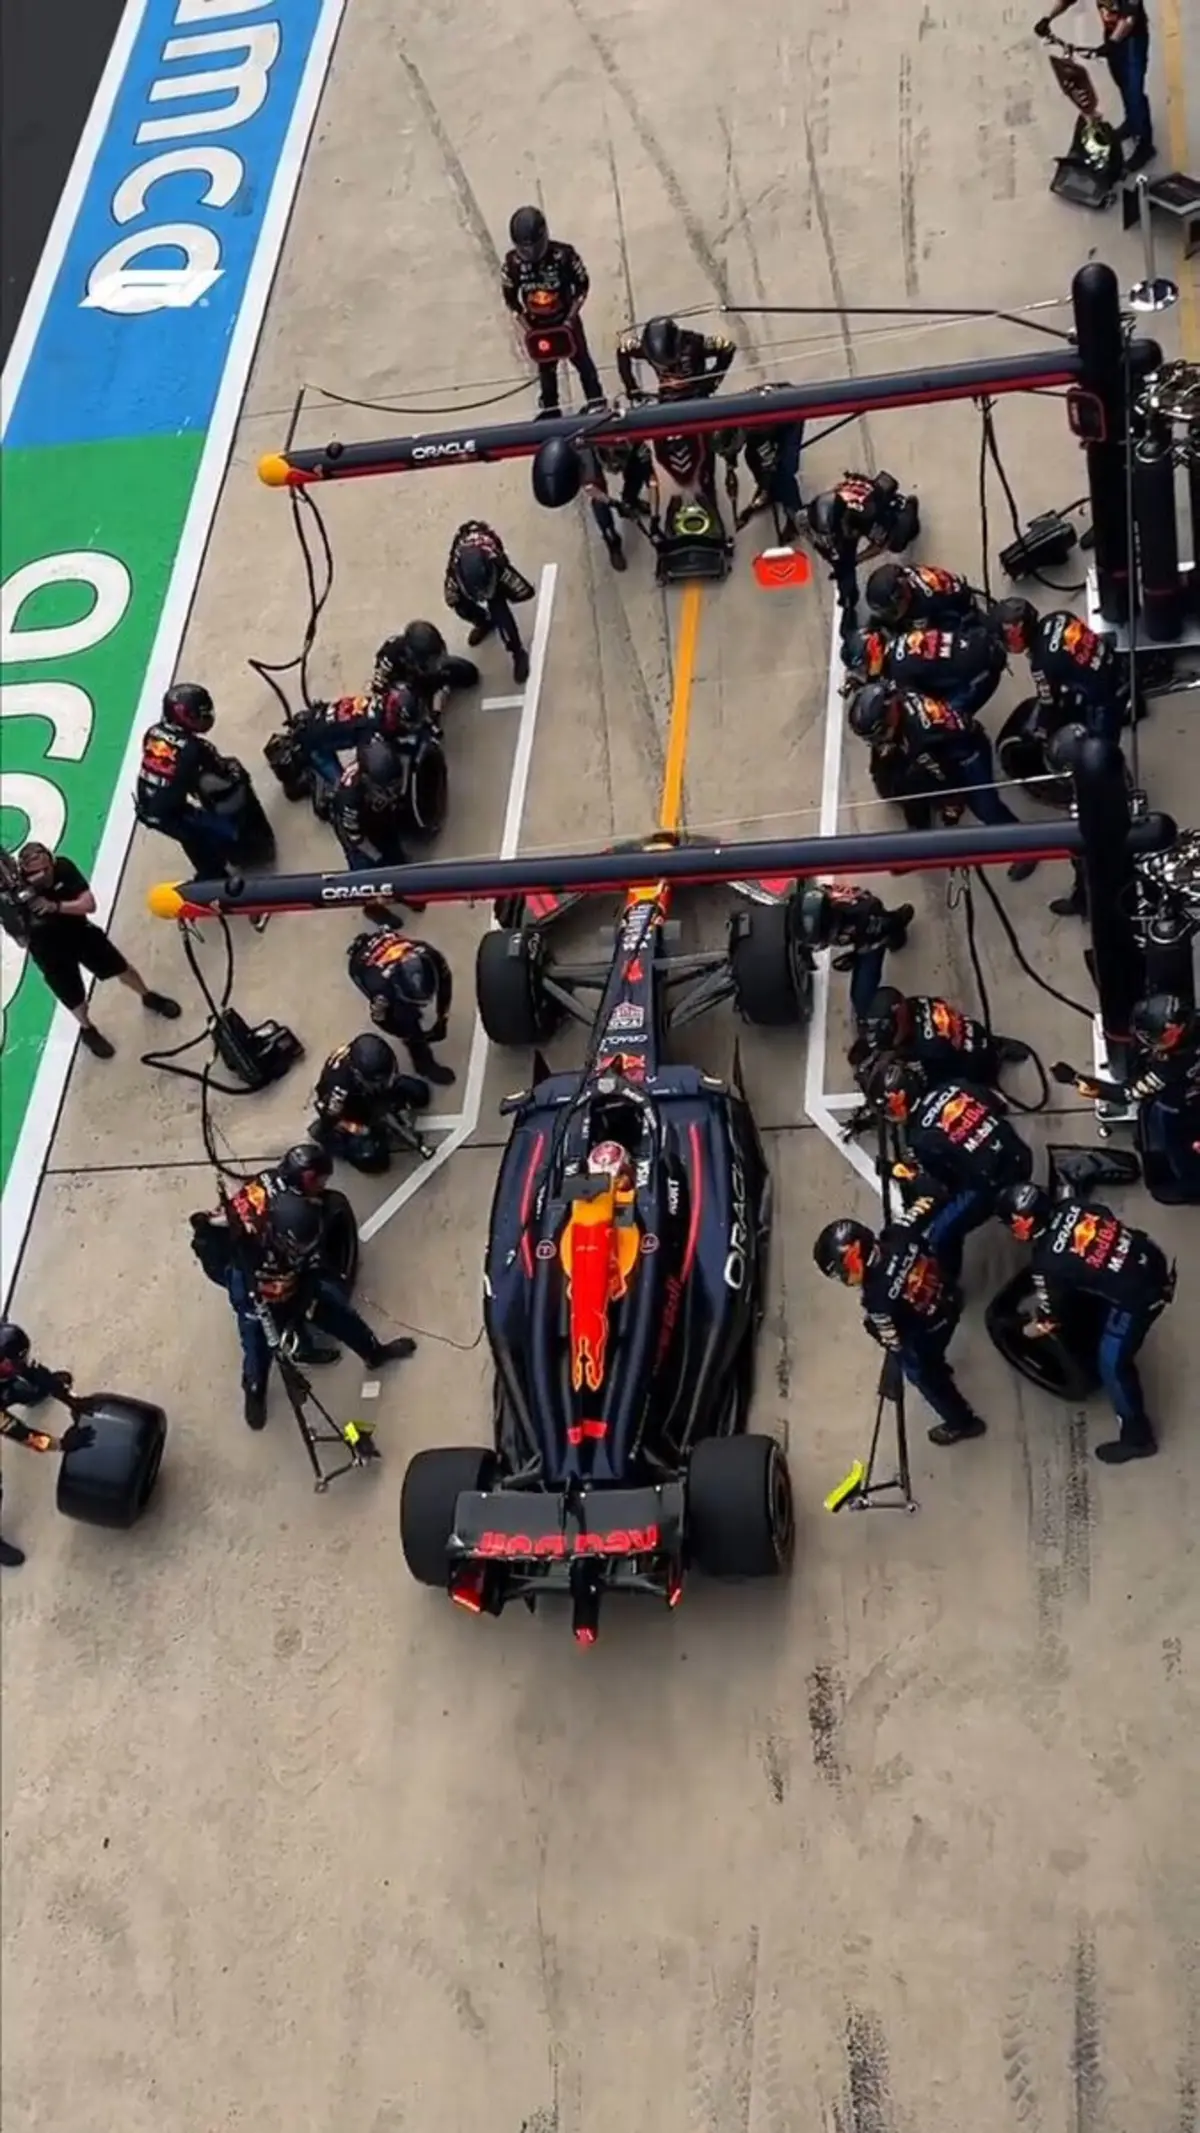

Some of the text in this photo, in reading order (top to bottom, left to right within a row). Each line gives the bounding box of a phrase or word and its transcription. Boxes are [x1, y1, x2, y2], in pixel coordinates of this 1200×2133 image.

[411, 439, 476, 460] ORACLE
[321, 883, 394, 900] ORACLE
[1053, 1205, 1081, 1254] ORACLE
